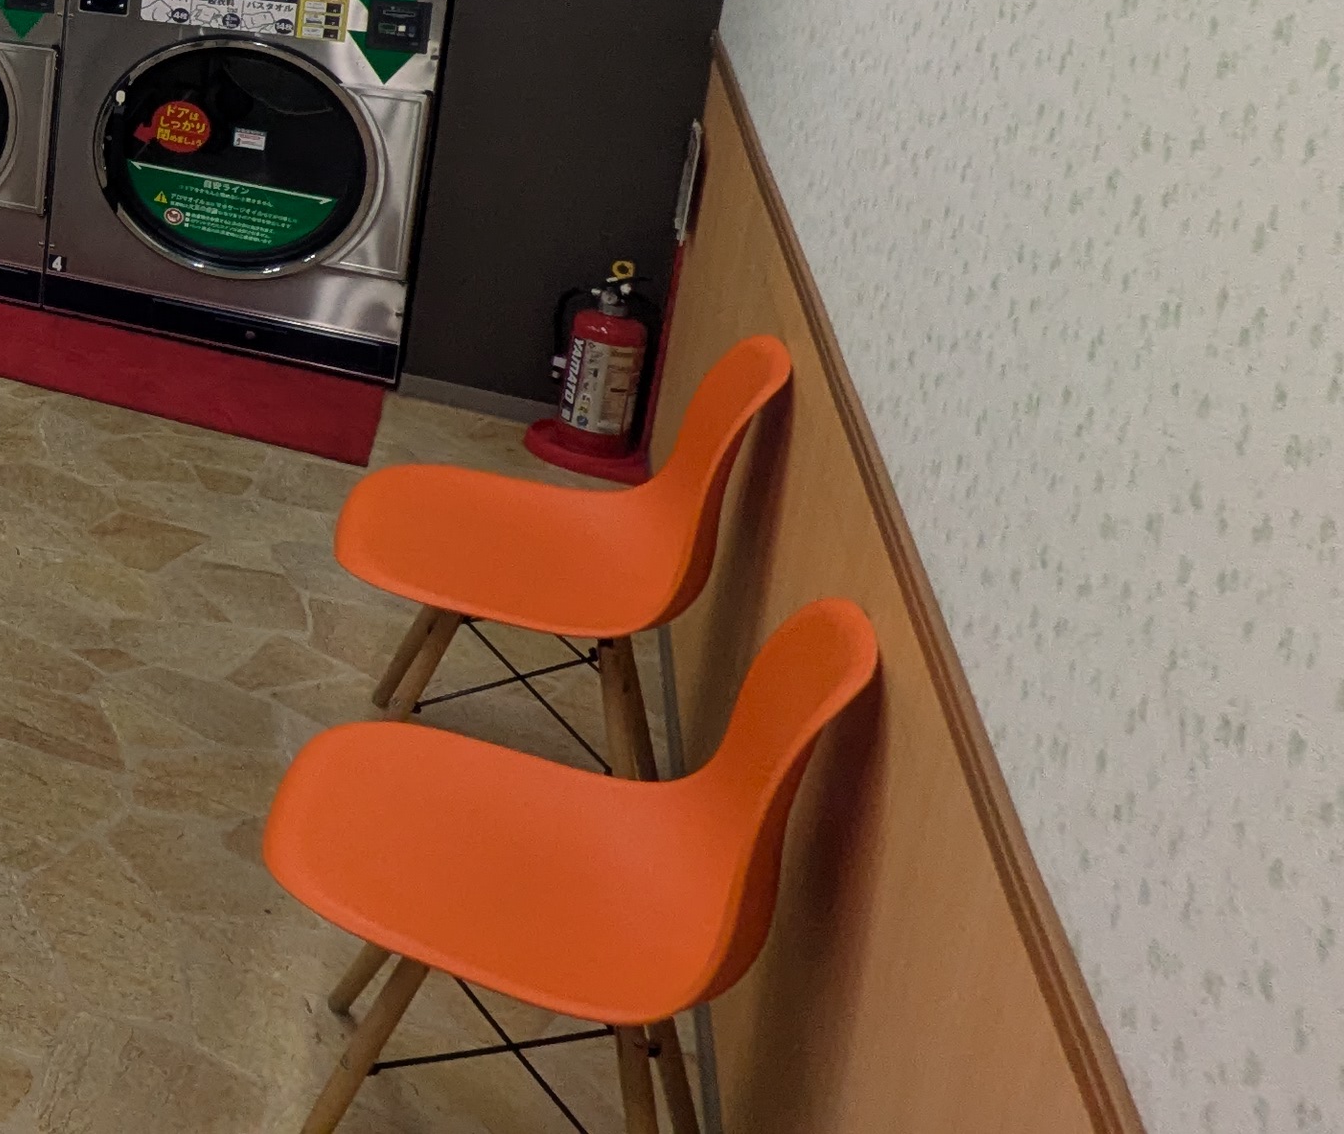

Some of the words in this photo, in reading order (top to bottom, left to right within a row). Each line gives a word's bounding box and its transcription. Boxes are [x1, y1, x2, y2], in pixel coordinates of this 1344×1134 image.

[247, 2, 293, 13] バスタオル
[166, 104, 199, 121] ドアは
[160, 116, 206, 134] しっかり
[203, 180, 250, 195] 目安ライン
[51, 257, 62, 271] 4
[565, 338, 584, 405] YAMATO
